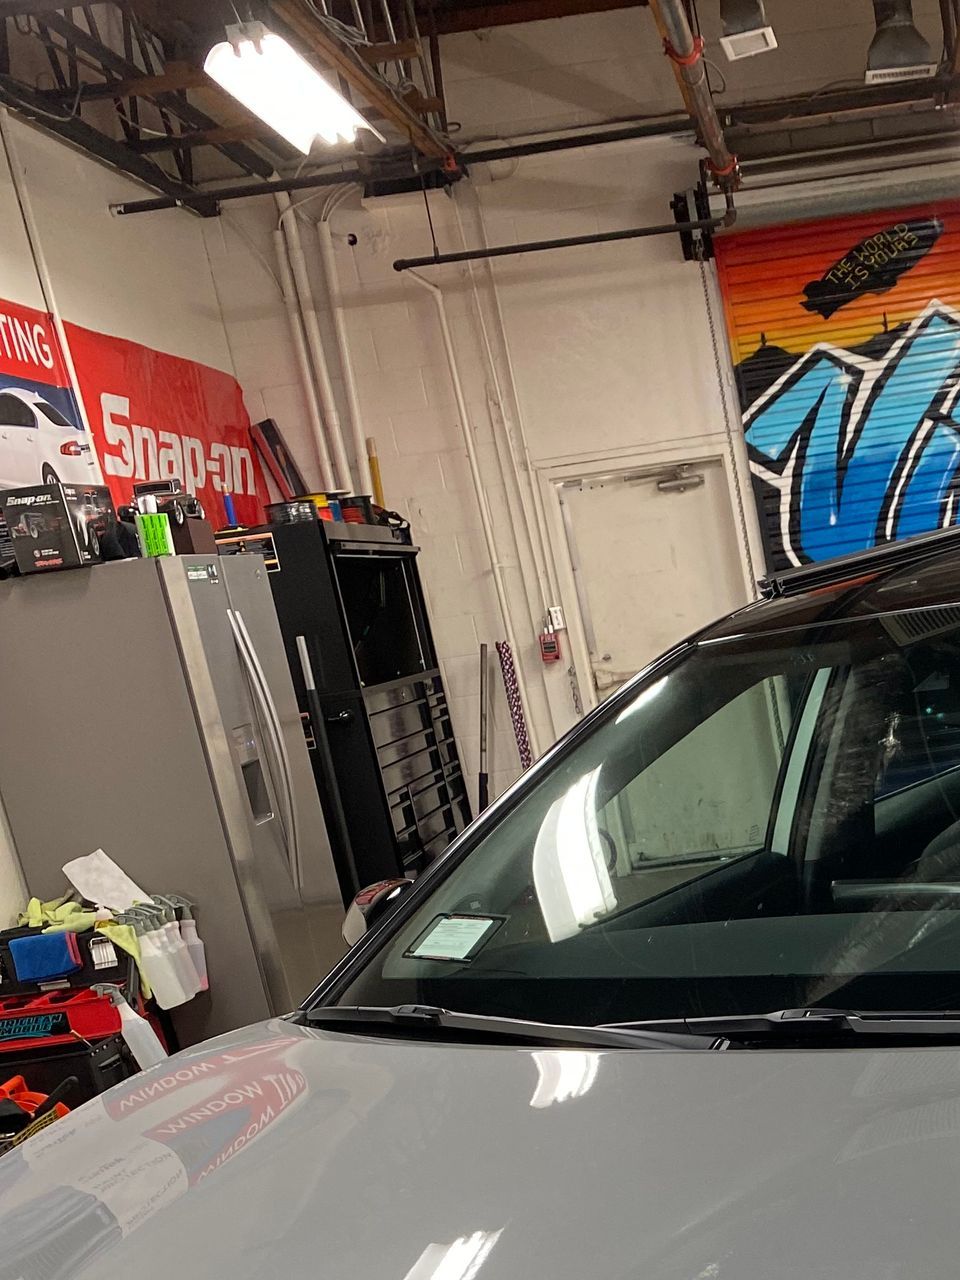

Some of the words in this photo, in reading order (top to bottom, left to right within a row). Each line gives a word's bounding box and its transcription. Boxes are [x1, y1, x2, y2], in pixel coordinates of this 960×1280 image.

[825, 258, 854, 284] THE
[853, 222, 909, 262] WORLD
[844, 265, 870, 290] IS
[864, 232, 919, 268] YOURS
[100, 391, 257, 497] Snap-on
[6, 494, 52, 507] Snap-on
[156, 1081, 264, 1135] WINDOW
